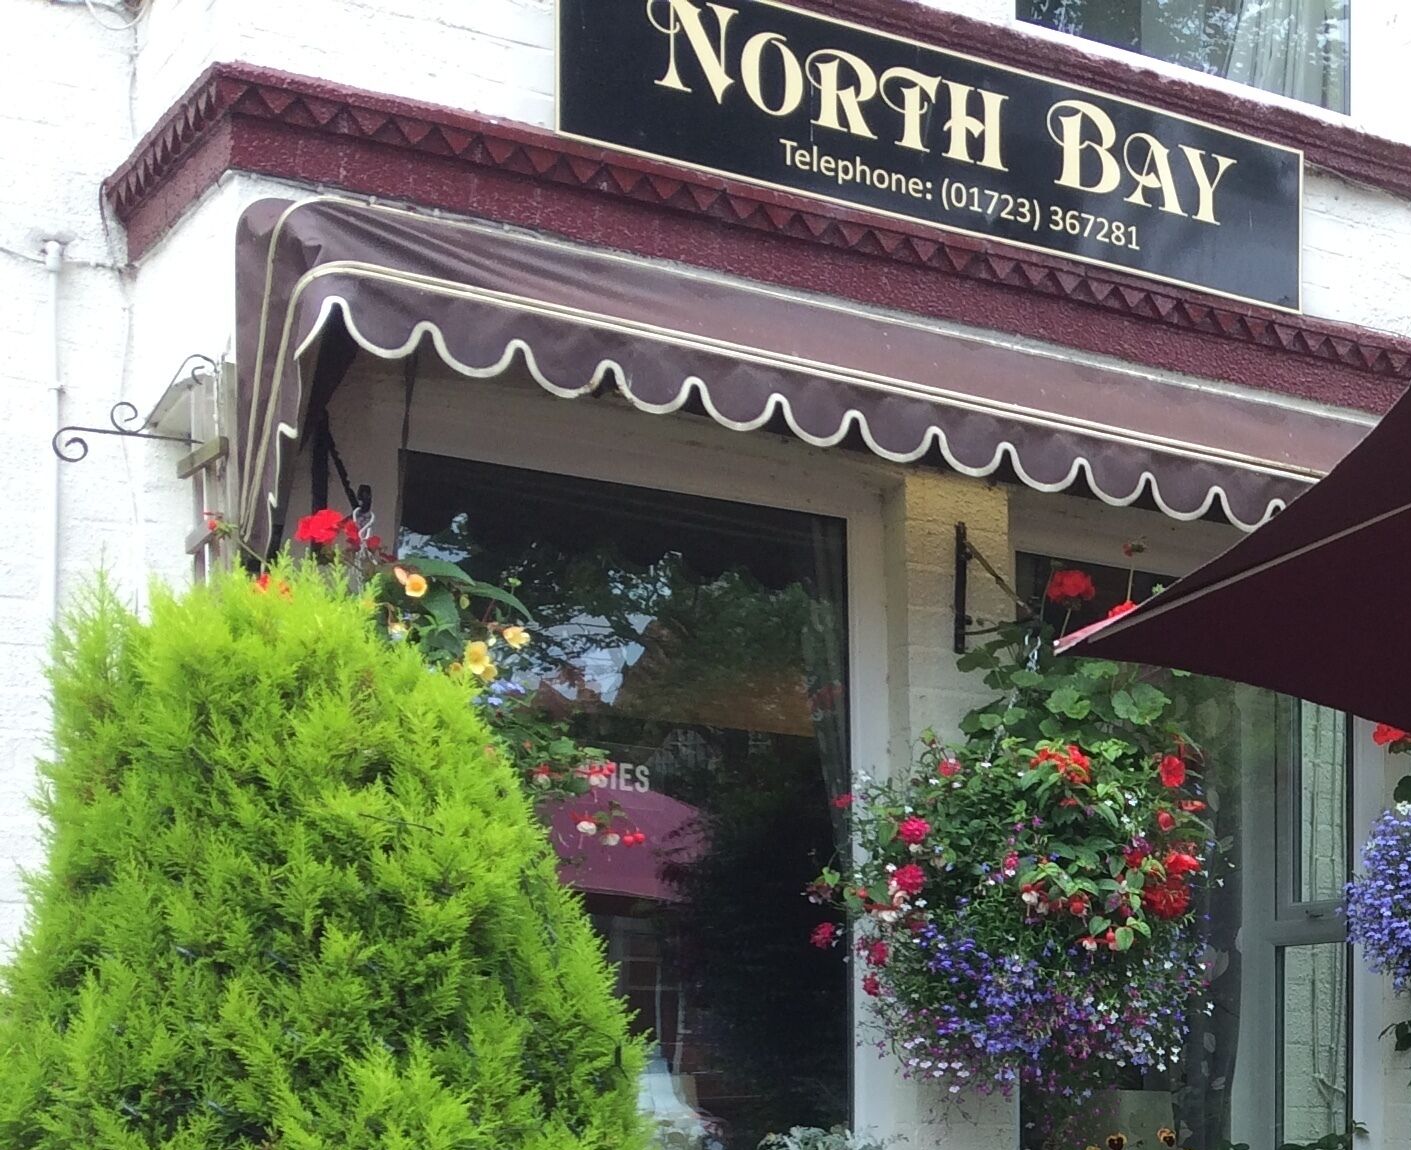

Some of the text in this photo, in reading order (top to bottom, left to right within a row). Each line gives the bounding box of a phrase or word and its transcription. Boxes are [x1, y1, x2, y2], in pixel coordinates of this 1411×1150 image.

[646, 0, 1238, 226] NORTH BAY
[779, 138, 1140, 250] Telephone: (01723) 367281
